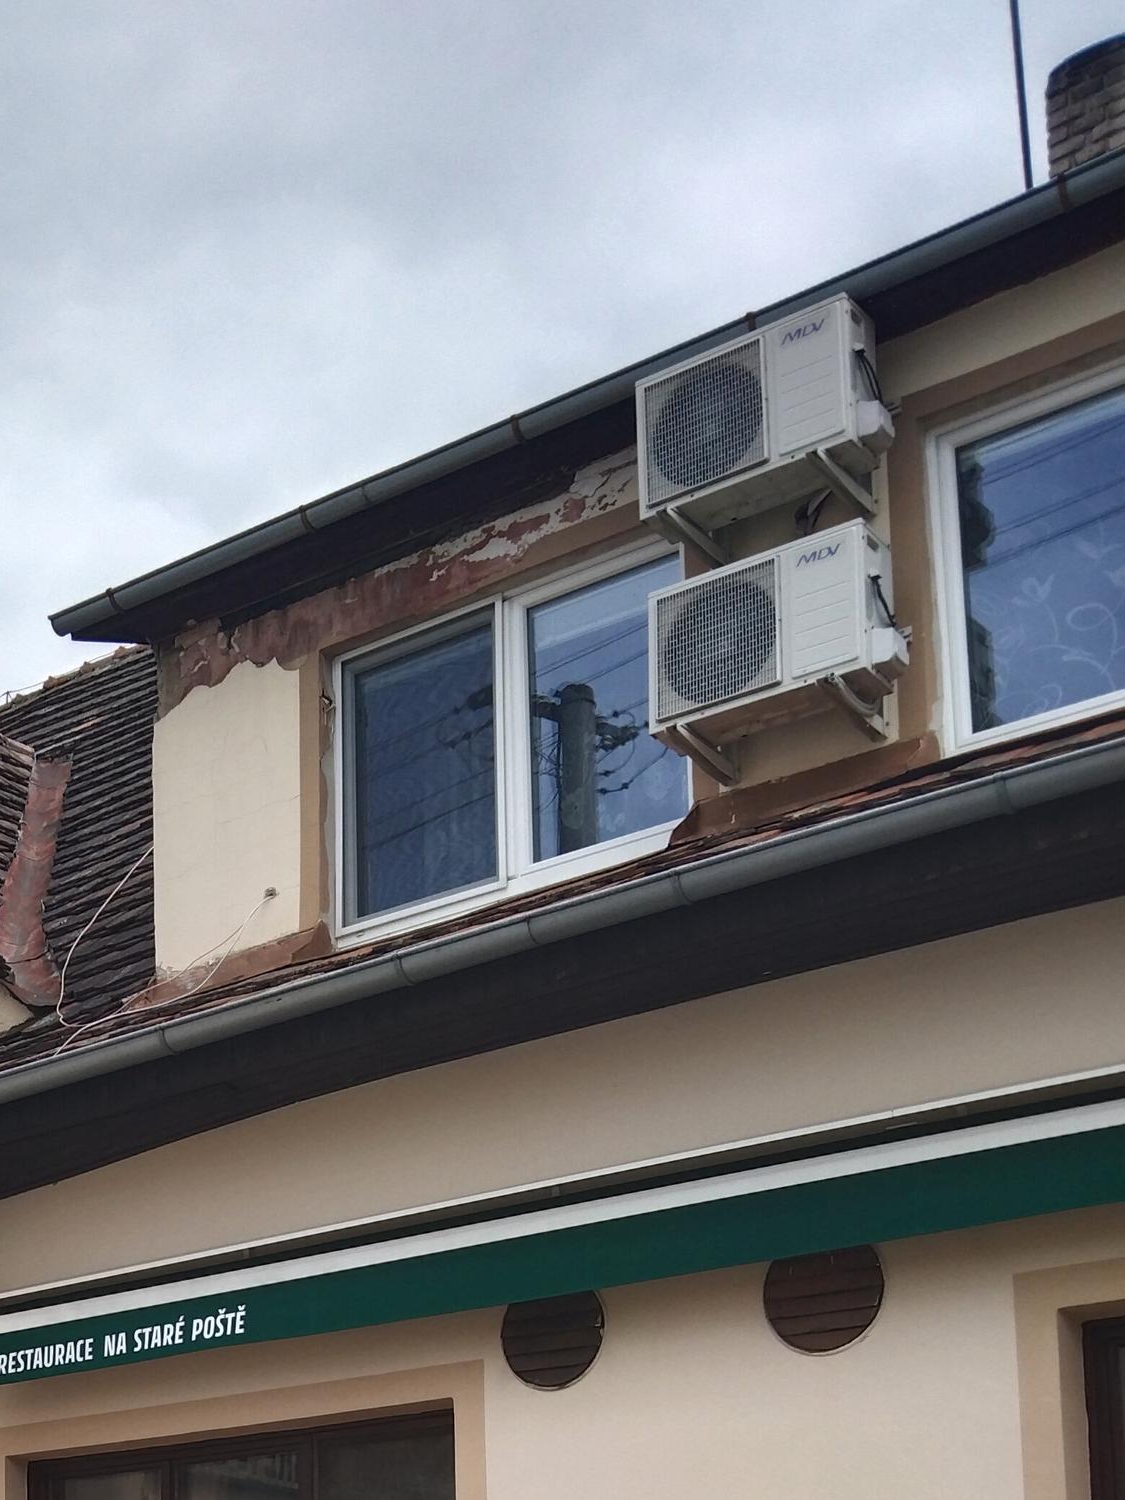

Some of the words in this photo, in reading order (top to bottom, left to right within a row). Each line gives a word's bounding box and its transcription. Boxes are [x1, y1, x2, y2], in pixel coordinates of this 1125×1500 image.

[781, 318, 825, 346] MDV
[797, 543, 840, 568] MDV
[103, 1331, 126, 1357] NA
[133, 1316, 185, 1352] STARÉ
[191, 1304, 247, 1341] POŠTĚ
